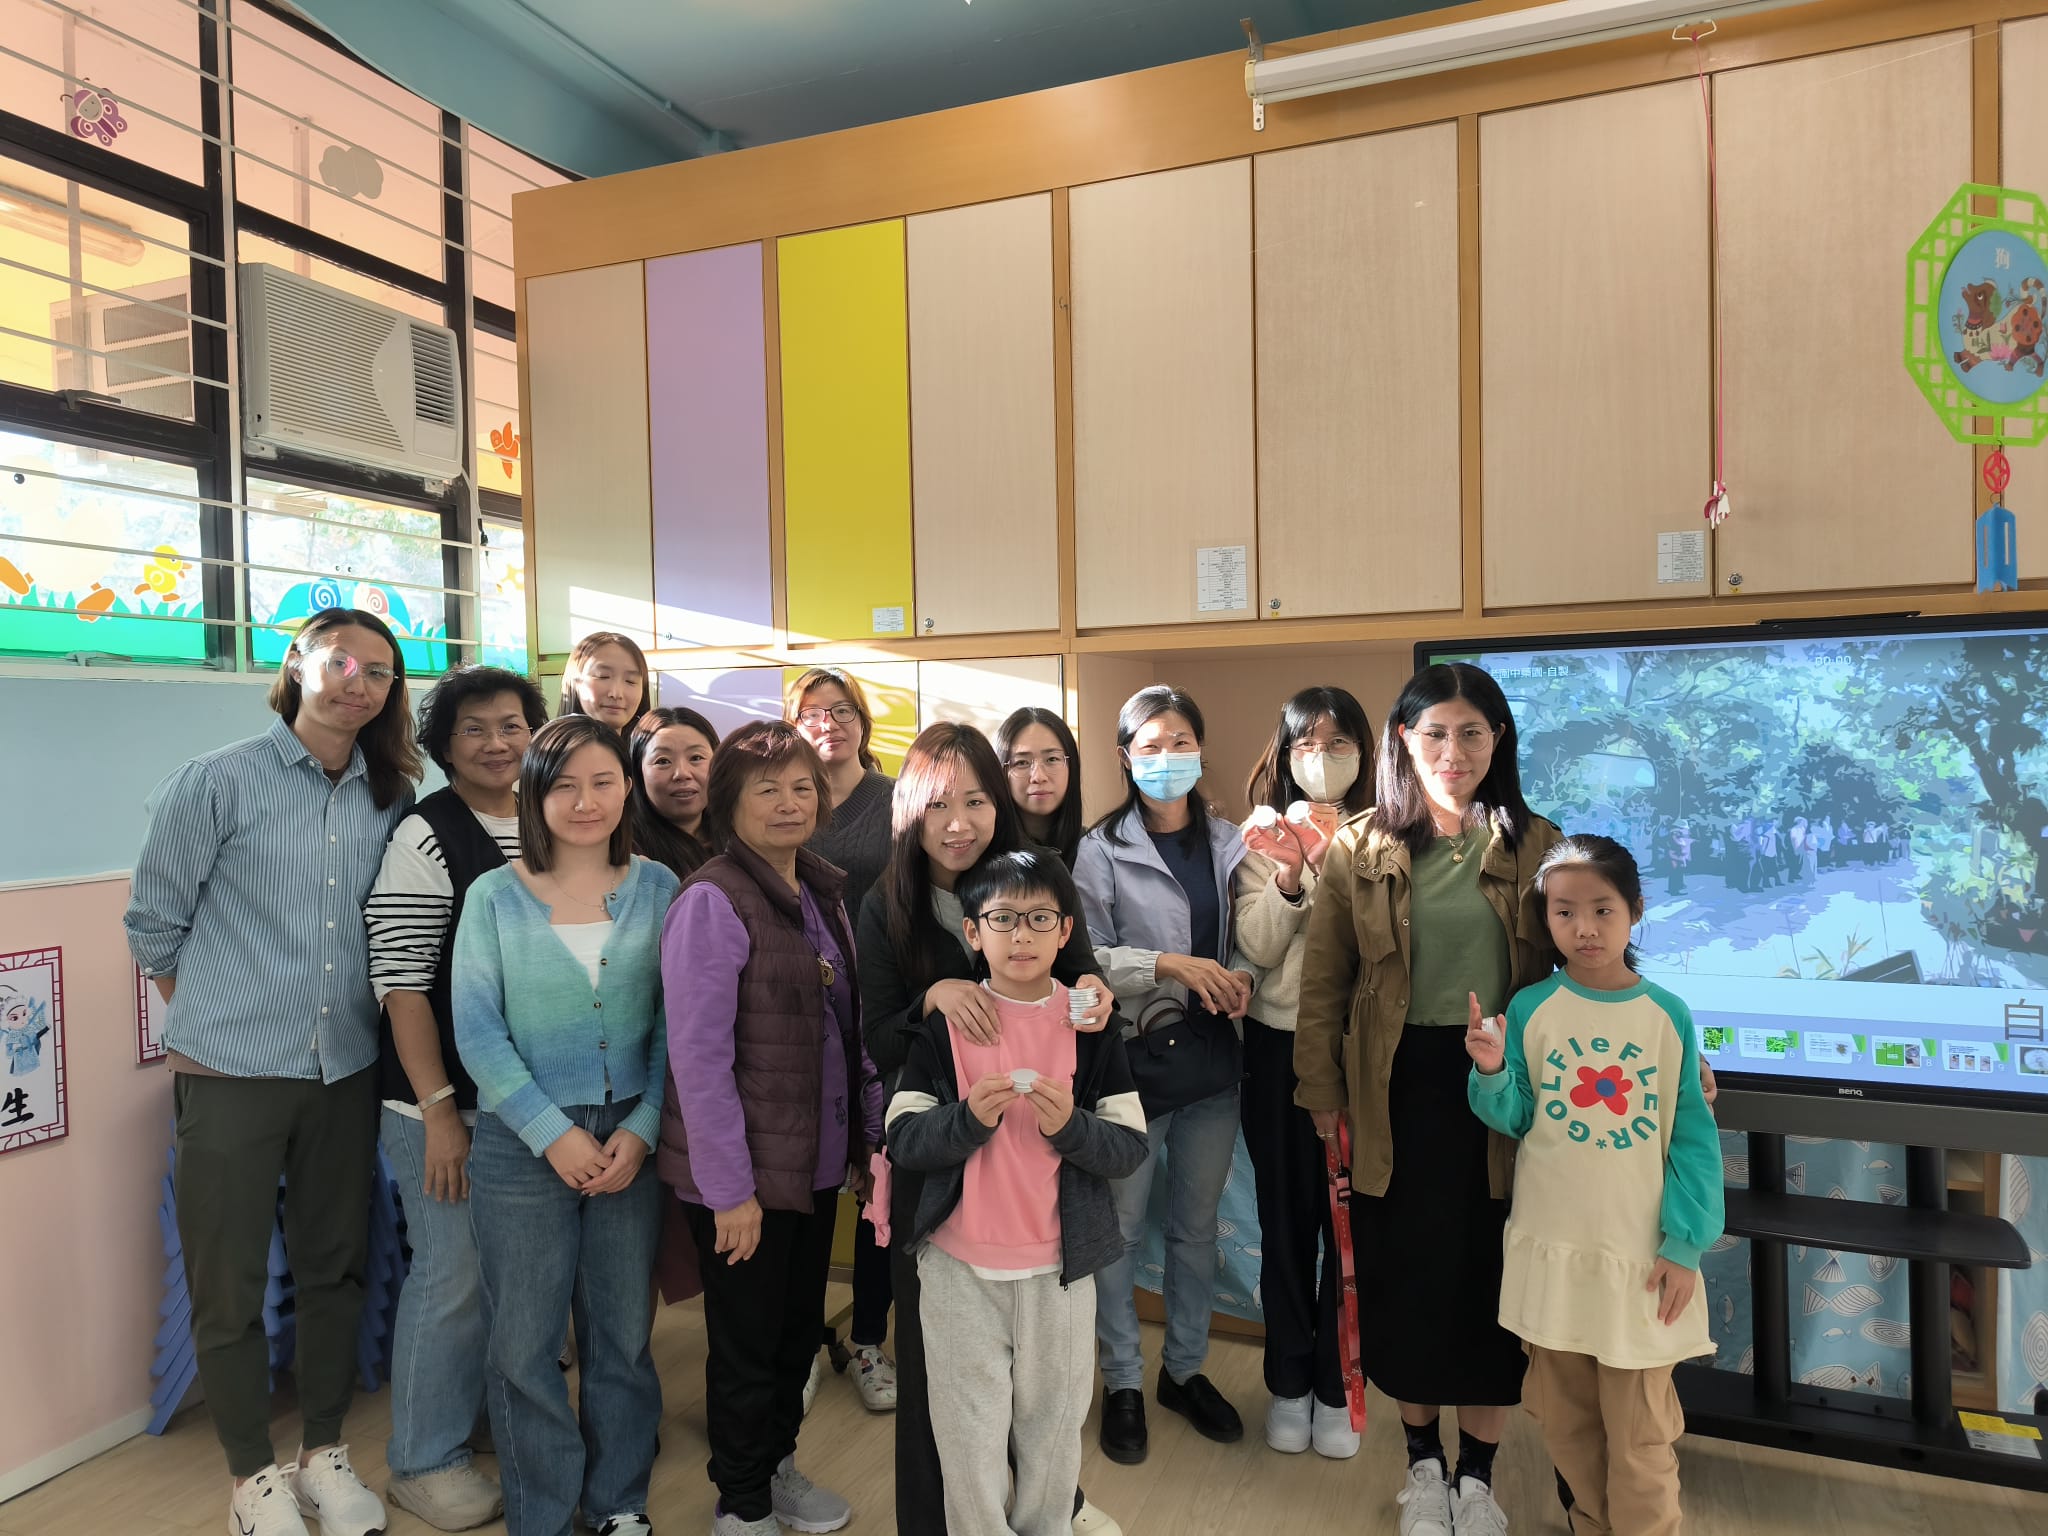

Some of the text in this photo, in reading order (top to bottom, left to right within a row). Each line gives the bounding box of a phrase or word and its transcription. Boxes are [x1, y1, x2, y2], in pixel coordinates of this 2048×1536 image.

[2004, 998, 2044, 1041] 自
[1, 1087, 34, 1127] 生
[1541, 1049, 1590, 1143] GOLF
